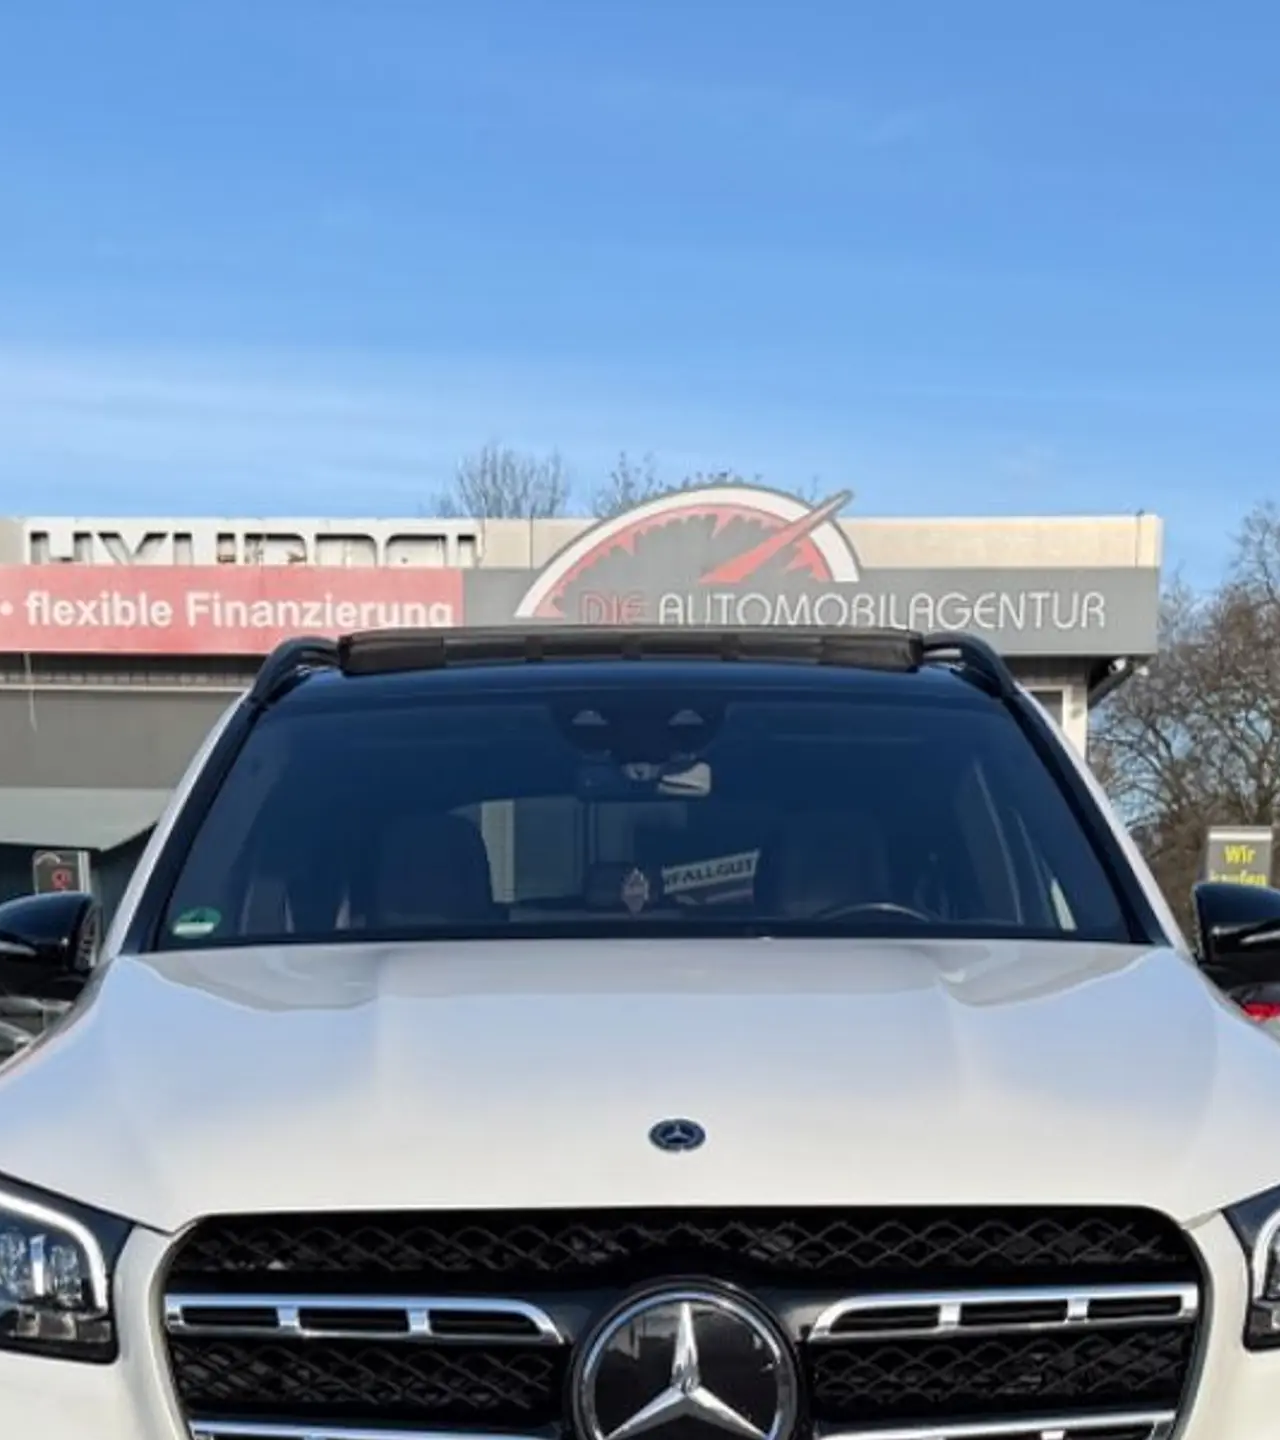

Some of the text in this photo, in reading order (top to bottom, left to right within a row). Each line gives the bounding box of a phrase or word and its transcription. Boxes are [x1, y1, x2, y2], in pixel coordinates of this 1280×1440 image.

[25, 589, 173, 627] flexible
[187, 592, 453, 629] Finanzierung
[580, 590, 1107, 630] DIE AUTOMOBILAGENTUR
